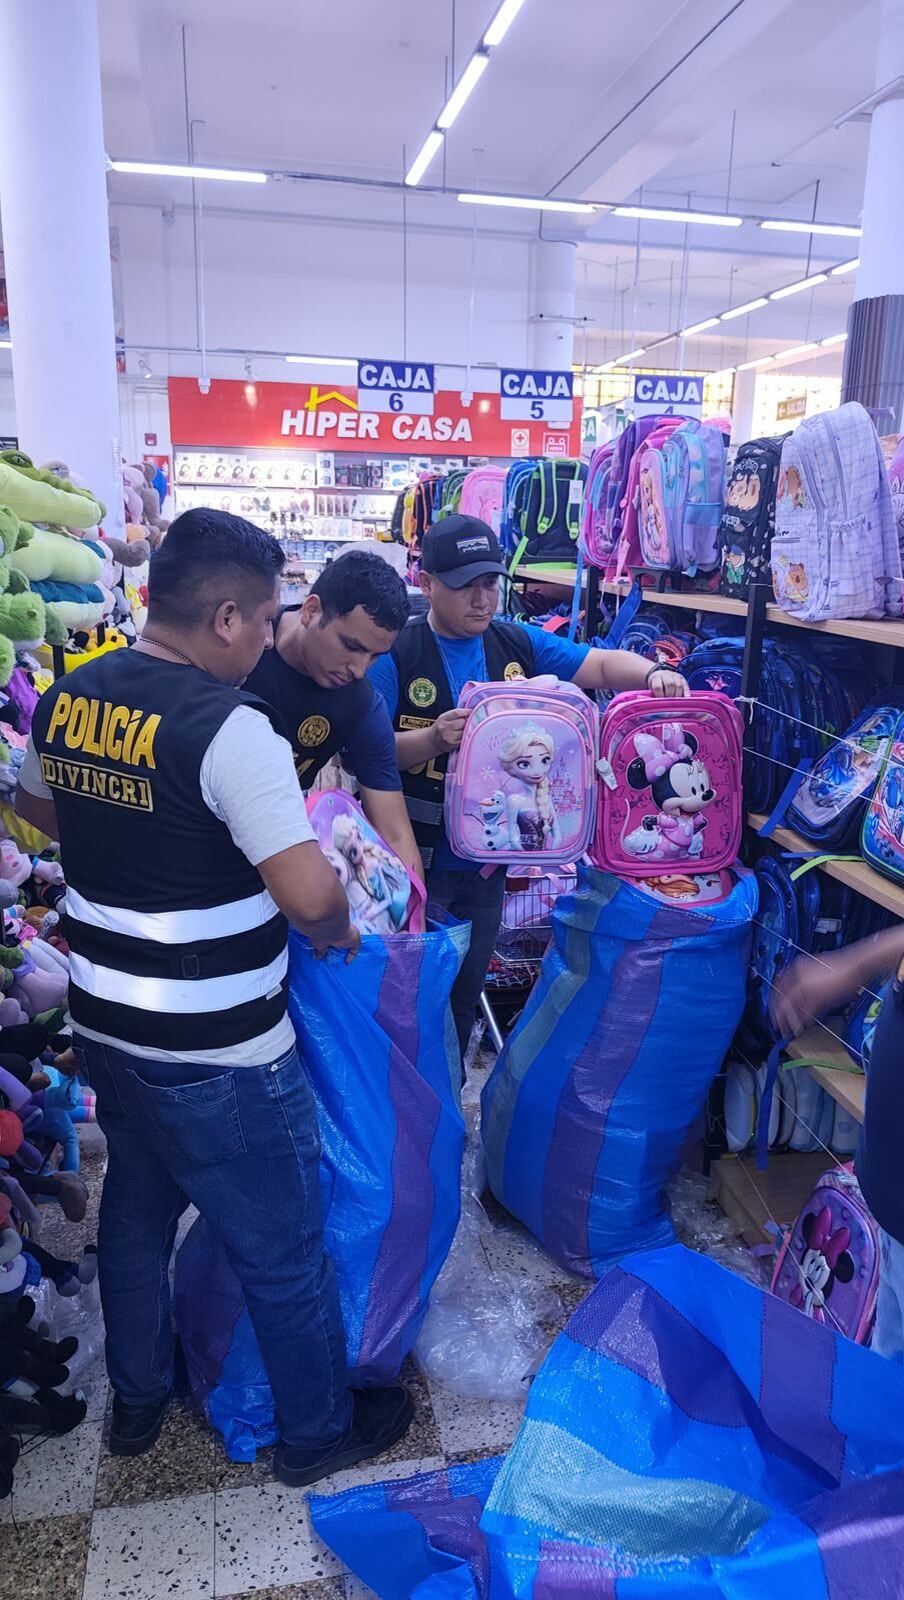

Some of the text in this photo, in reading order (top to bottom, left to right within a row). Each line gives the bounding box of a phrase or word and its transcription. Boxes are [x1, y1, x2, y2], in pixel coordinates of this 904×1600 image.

[359, 364, 431, 390] CAJA
[502, 374, 571, 397] CAJA
[388, 392, 404, 412] 6
[636, 379, 700, 402] CAJA
[530, 400, 544, 419] 5
[280, 409, 472, 442] HIPER CASA
[45, 692, 162, 770] POLICÍA
[43, 758, 149, 807] DIVINCRI
